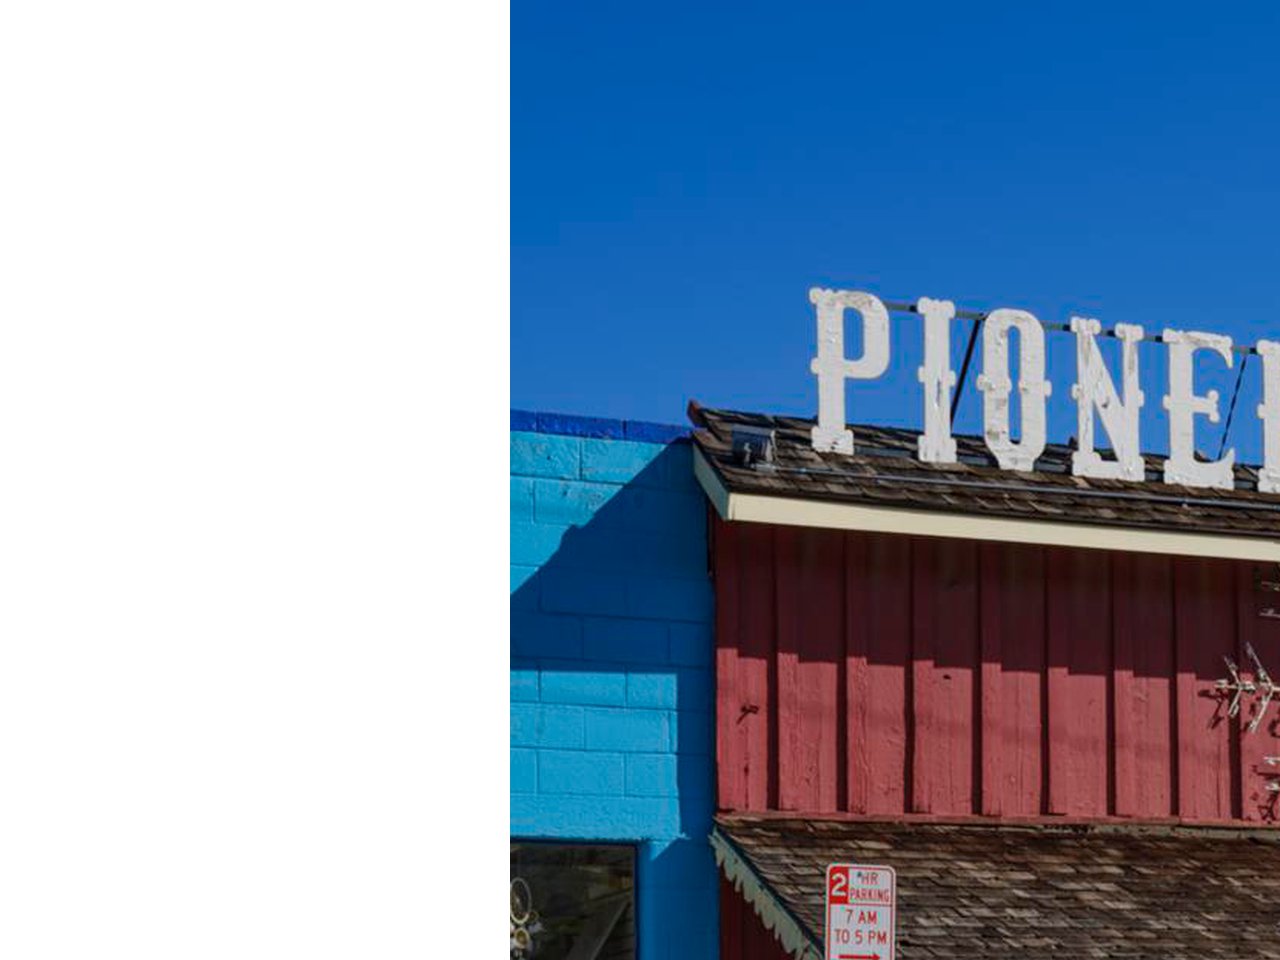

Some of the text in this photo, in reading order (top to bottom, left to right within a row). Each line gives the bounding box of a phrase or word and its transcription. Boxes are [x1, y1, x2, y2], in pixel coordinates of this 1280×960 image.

[832, 872, 847, 896] 2
[861, 872, 879, 885] HR
[850, 888, 890, 903] PARKING
[845, 909, 877, 925] 7 AM
[834, 928, 887, 945] TO 5 PM
